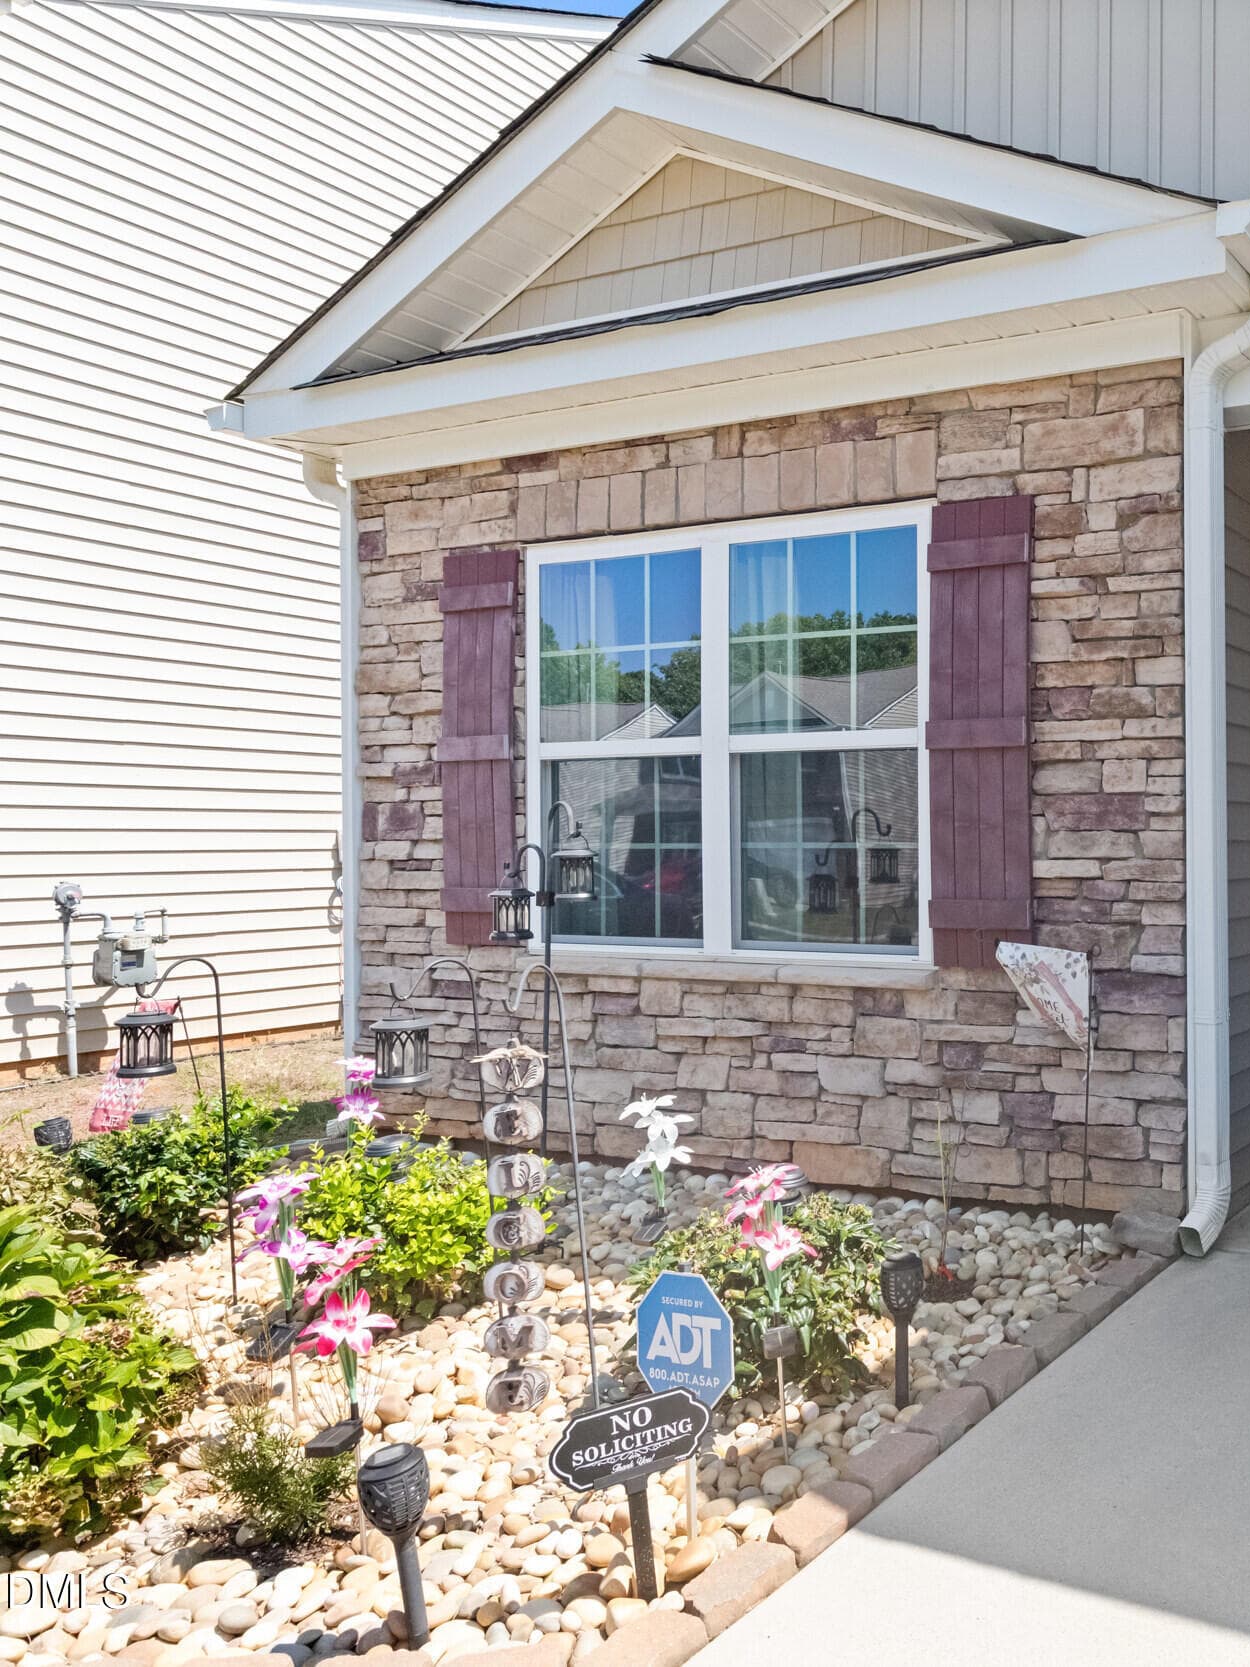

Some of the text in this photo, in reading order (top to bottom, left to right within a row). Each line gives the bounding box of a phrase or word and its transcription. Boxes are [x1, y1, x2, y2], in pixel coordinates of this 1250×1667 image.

[661, 1296, 704, 1309] SECURED BY
[646, 1312, 722, 1369] ADT
[649, 1367, 720, 1388] 800.ADT.ASAP
[610, 1406, 652, 1435] NO
[572, 1417, 693, 1468] SOLICITING
